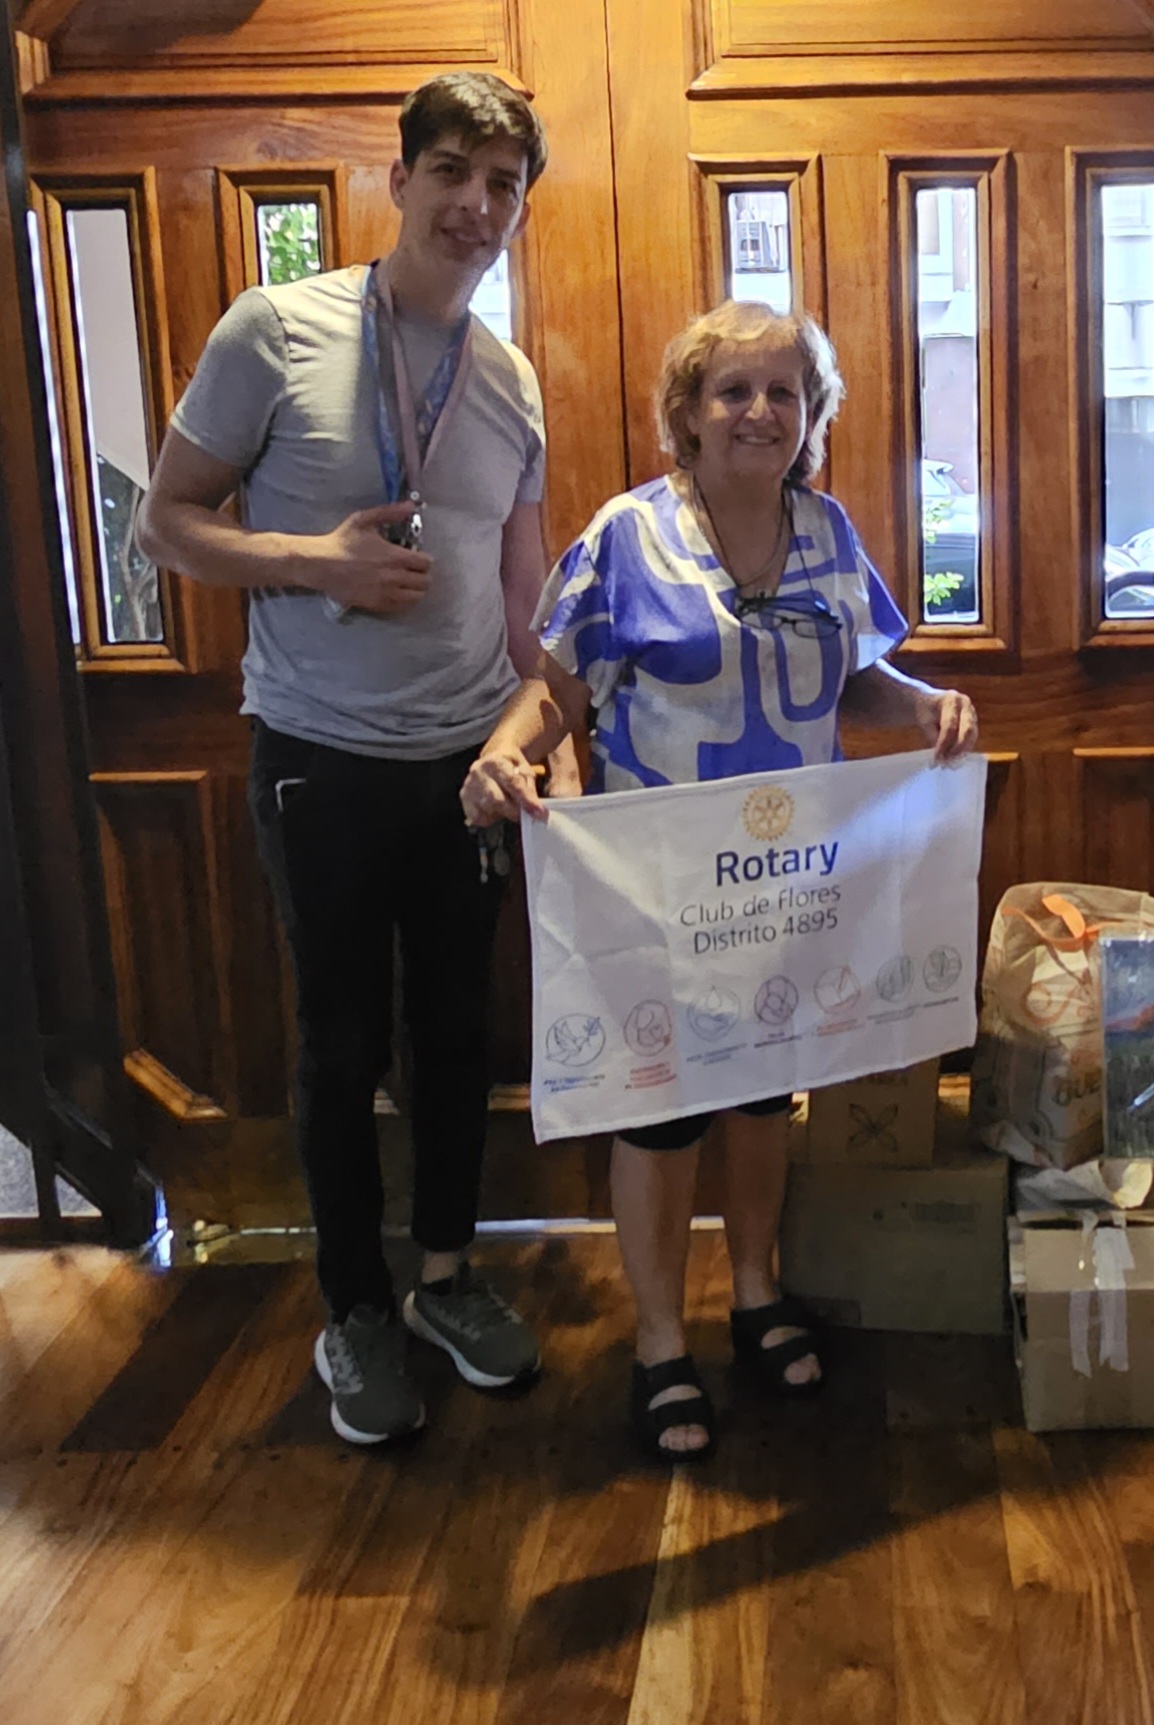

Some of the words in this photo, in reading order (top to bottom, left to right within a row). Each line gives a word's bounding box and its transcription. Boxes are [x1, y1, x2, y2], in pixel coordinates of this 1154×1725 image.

[716, 841, 839, 887] Rotary
[680, 899, 734, 927] Club
[743, 894, 770, 918] de
[778, 884, 842, 911] Flores
[693, 922, 777, 955] Distrito
[782, 907, 838, 936] 4895
